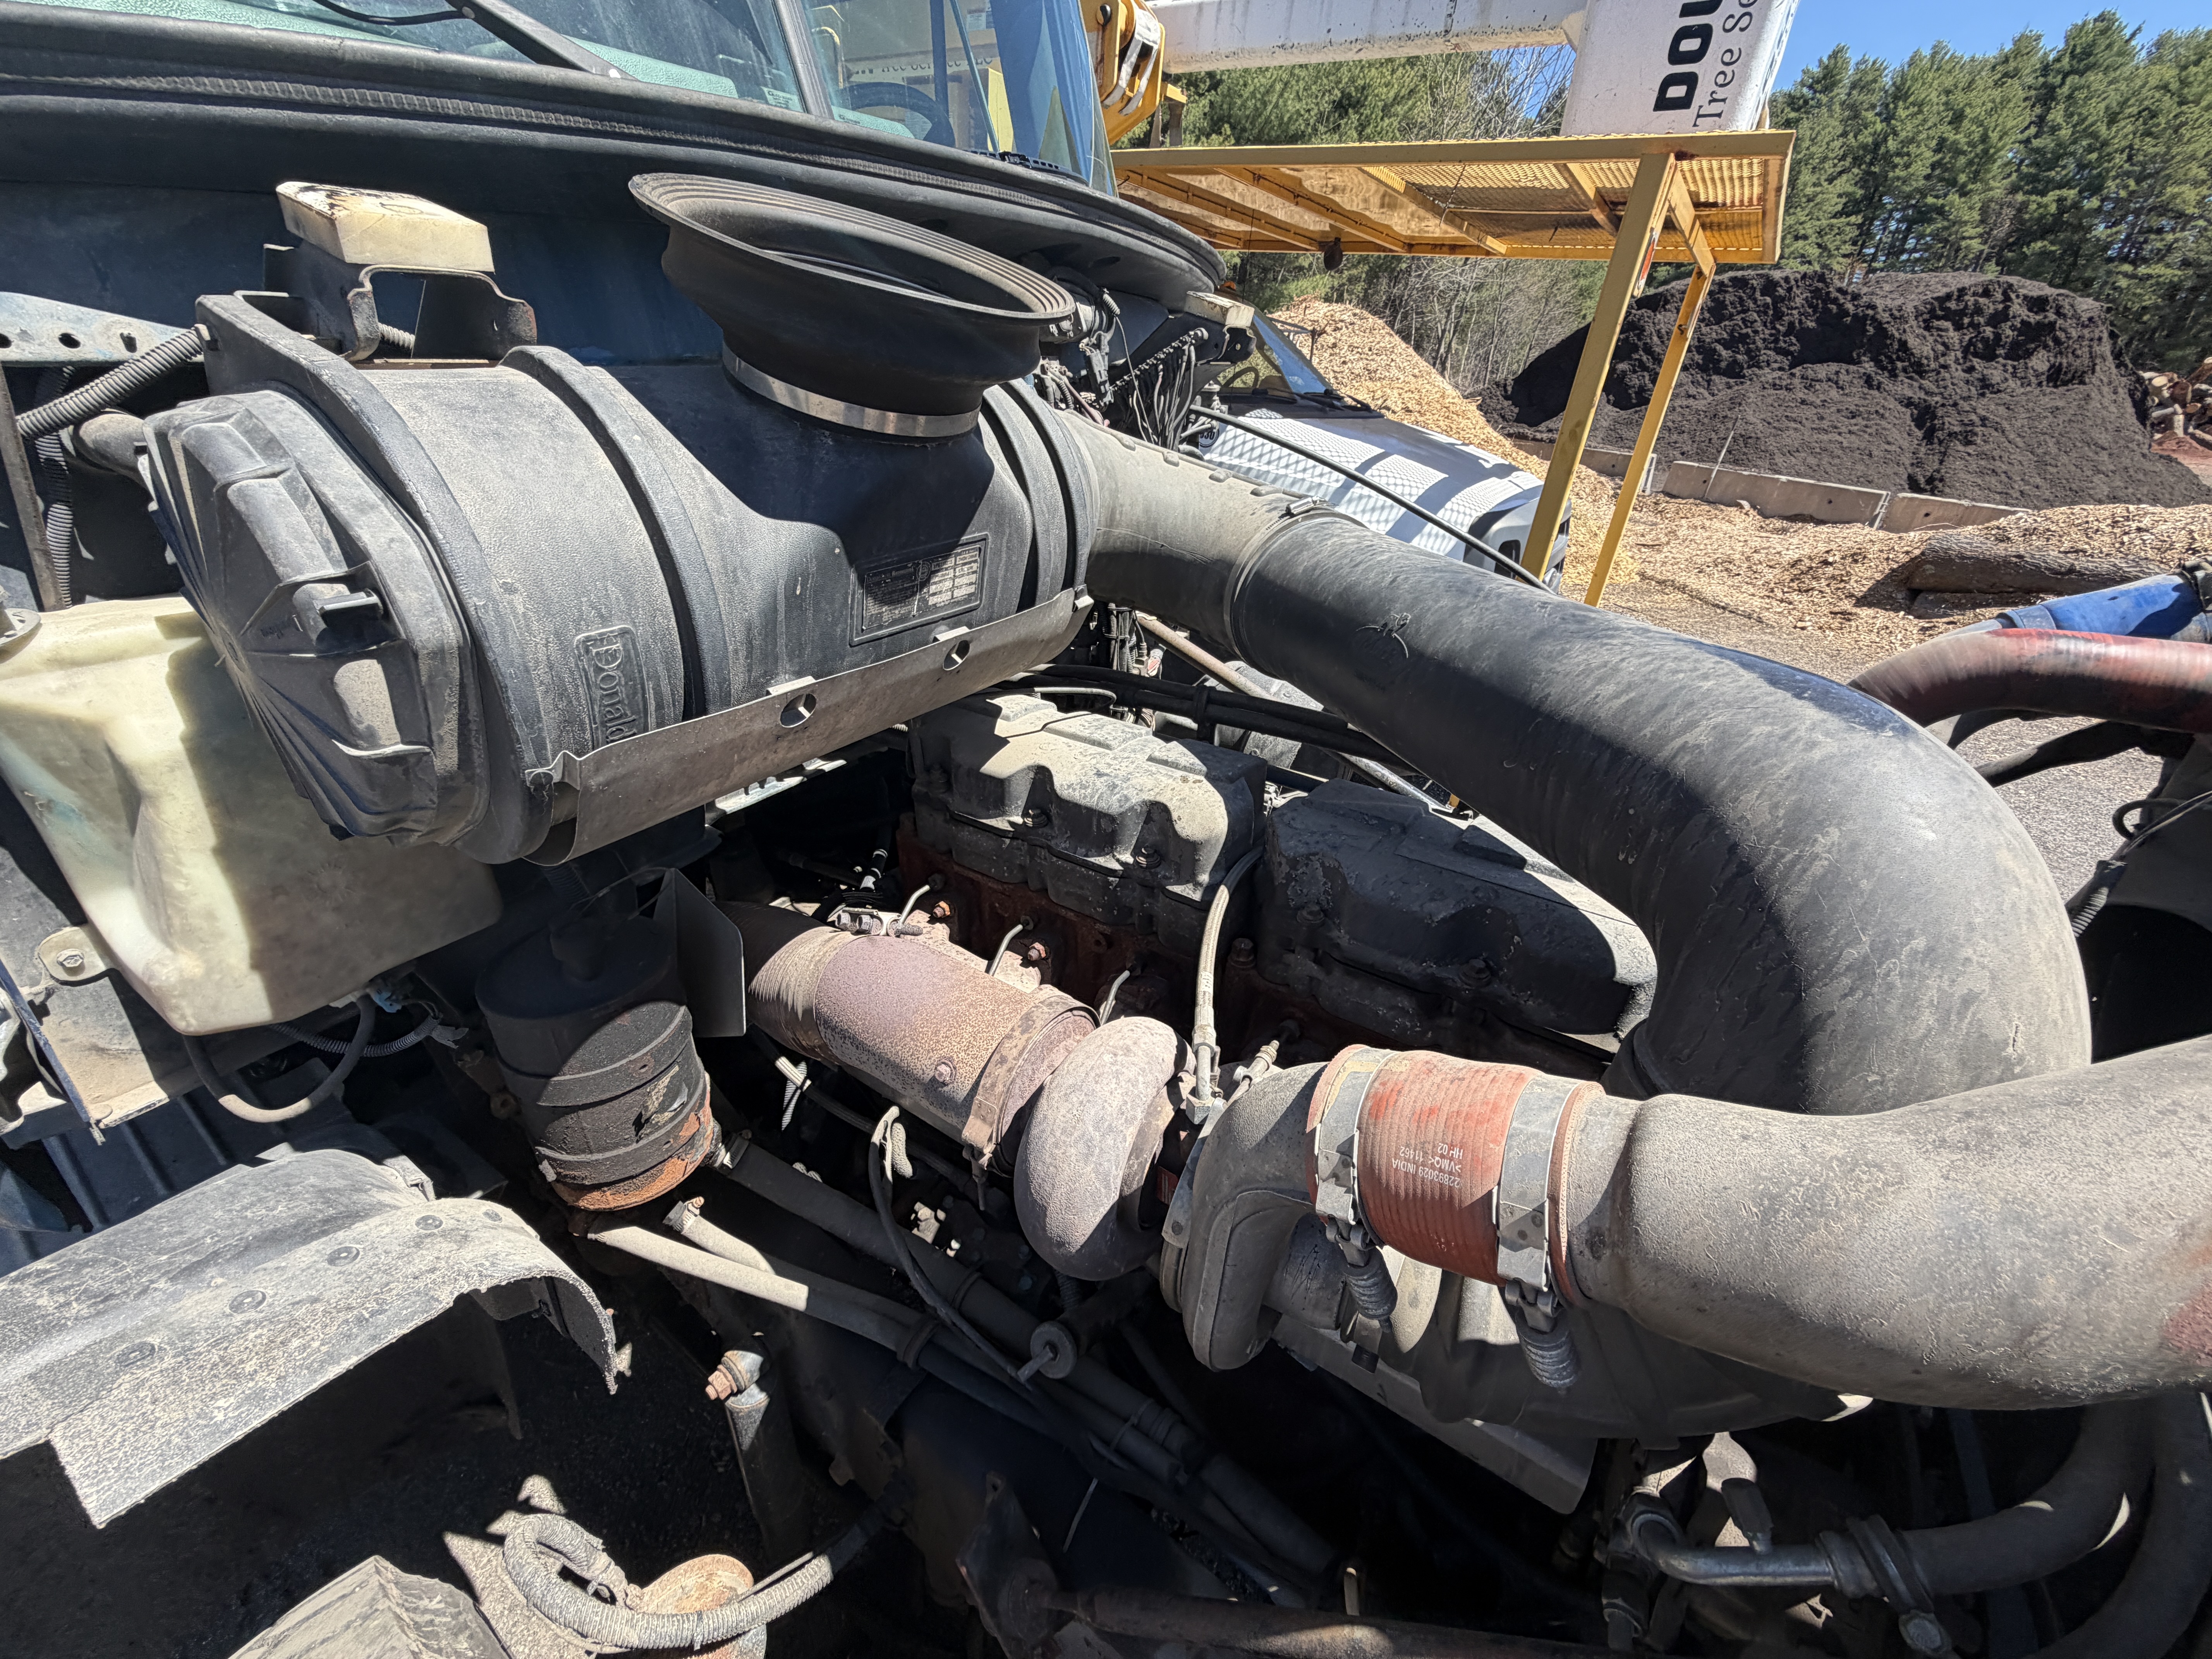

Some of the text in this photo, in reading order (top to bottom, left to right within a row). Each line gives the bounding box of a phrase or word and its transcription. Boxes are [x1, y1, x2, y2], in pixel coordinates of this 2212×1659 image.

[1692, 47, 1742, 128] Tree
[1399, 1146, 1424, 1163] 11462
[1437, 1142, 1448, 1155] 02
[1392, 1158, 1461, 1188] 22893029 INDIA
